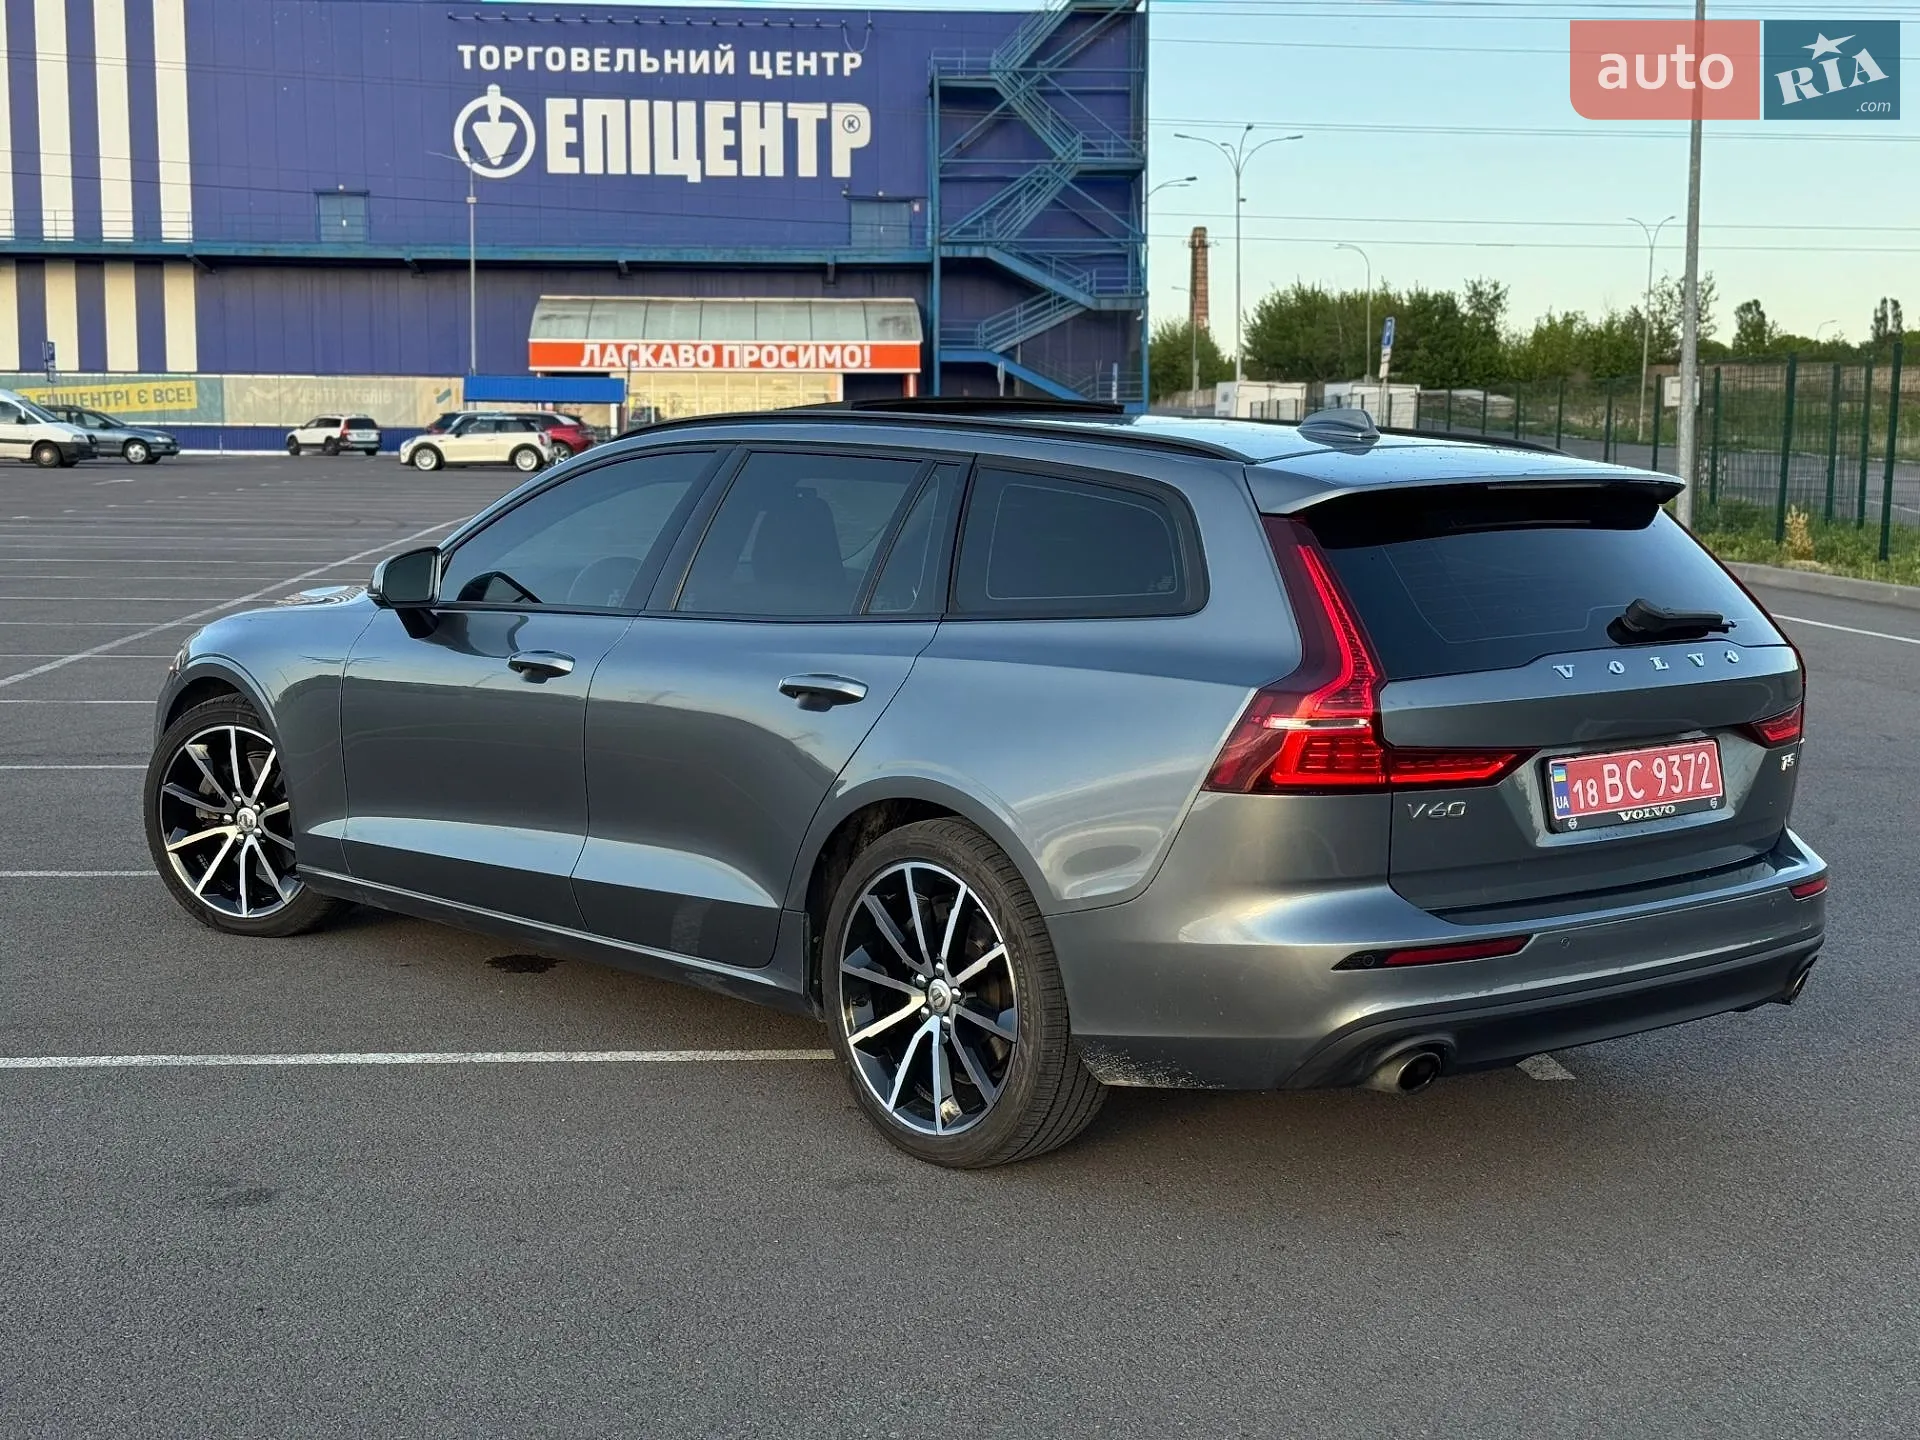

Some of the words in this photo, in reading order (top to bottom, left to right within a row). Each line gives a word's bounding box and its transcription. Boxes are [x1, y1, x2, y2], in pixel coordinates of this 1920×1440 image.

[457, 43, 736, 75] ТОРГОВЕЛЬНИЙ
[749, 51, 863, 79] ЦЕНТР
[546, 98, 871, 182] ЕПІЦЕНТР
[580, 343, 715, 369] ЛАСКАВО
[723, 343, 872, 369] ПРОСИМО!
[137, 390, 148, 404] Є
[152, 387, 192, 404] ВСЕ!
[1552, 649, 1740, 679] VOLVO
[1572, 778, 1599, 809] 18
[1602, 759, 1645, 804] BC
[1651, 751, 1714, 797] 9372
[1407, 801, 1467, 819] V60
[1556, 796, 1570, 809] UA
[1617, 805, 1676, 822] VOLVO
